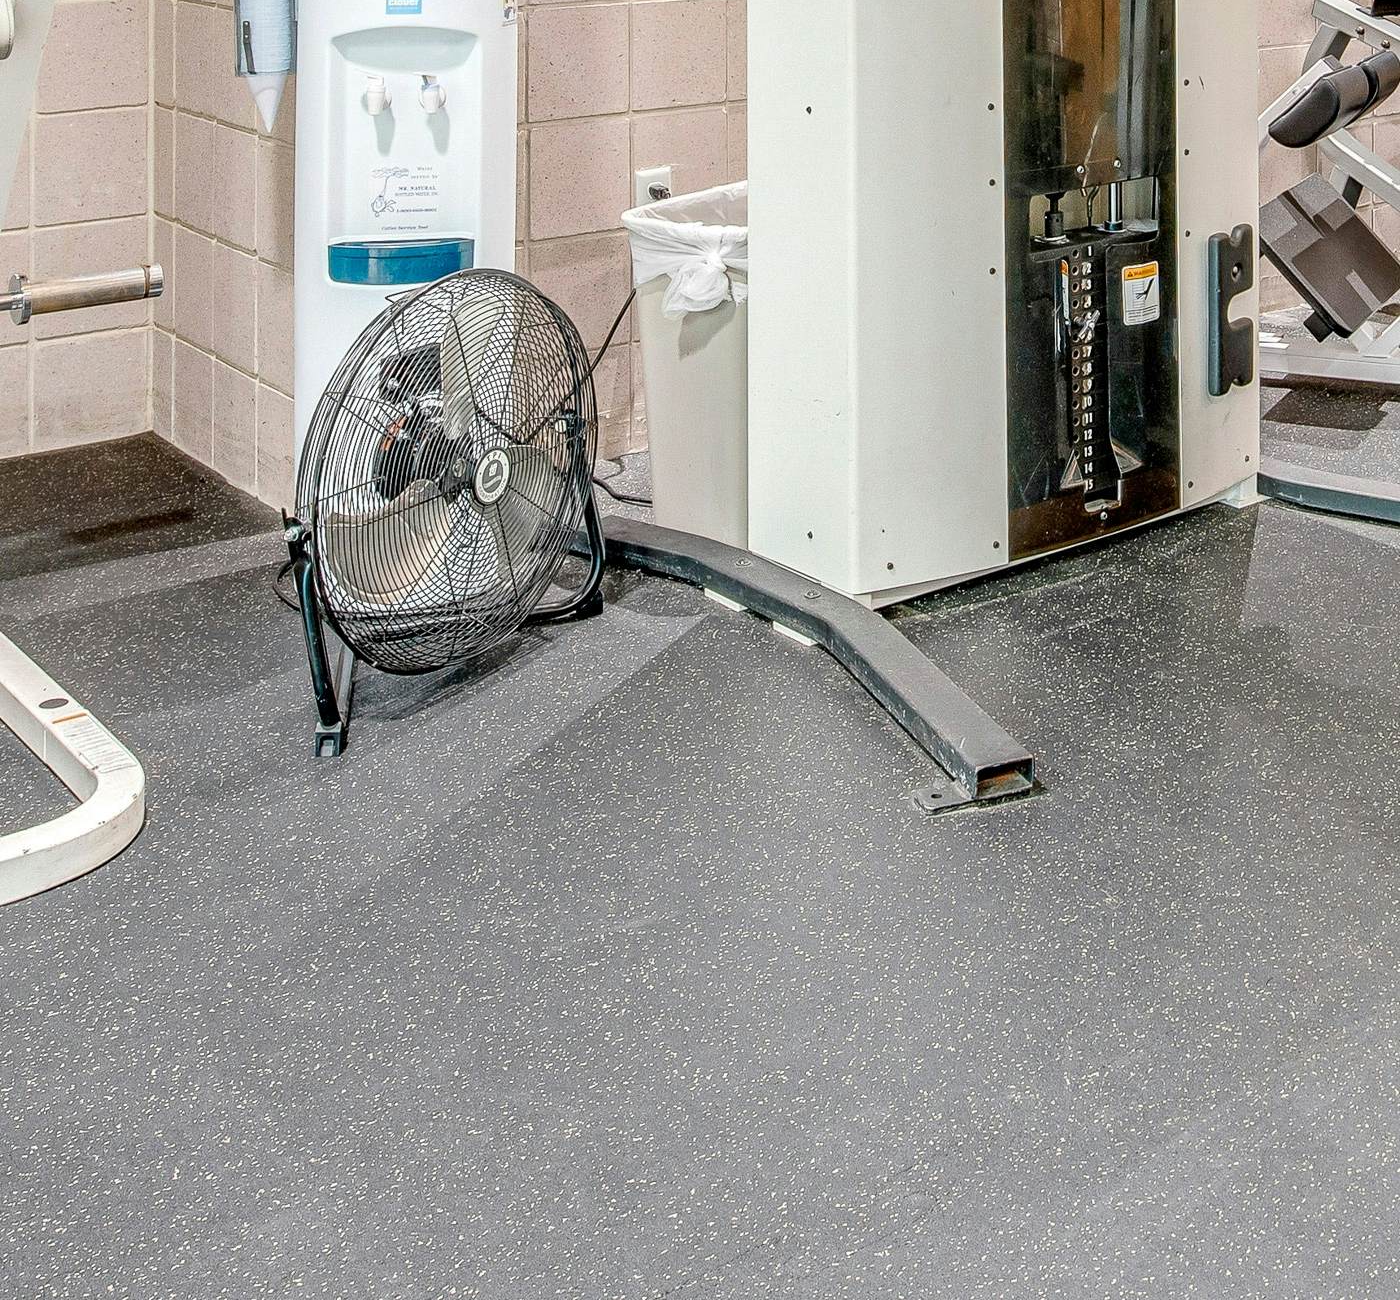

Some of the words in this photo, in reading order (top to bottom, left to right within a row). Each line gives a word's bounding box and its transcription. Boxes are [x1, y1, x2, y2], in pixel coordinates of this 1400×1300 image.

[1082, 396, 1092, 409] 10
[1084, 429, 1092, 440] 12
[1084, 446, 1092, 458] 13
[1084, 462, 1093, 474] 14
[1085, 479, 1094, 493] 15
